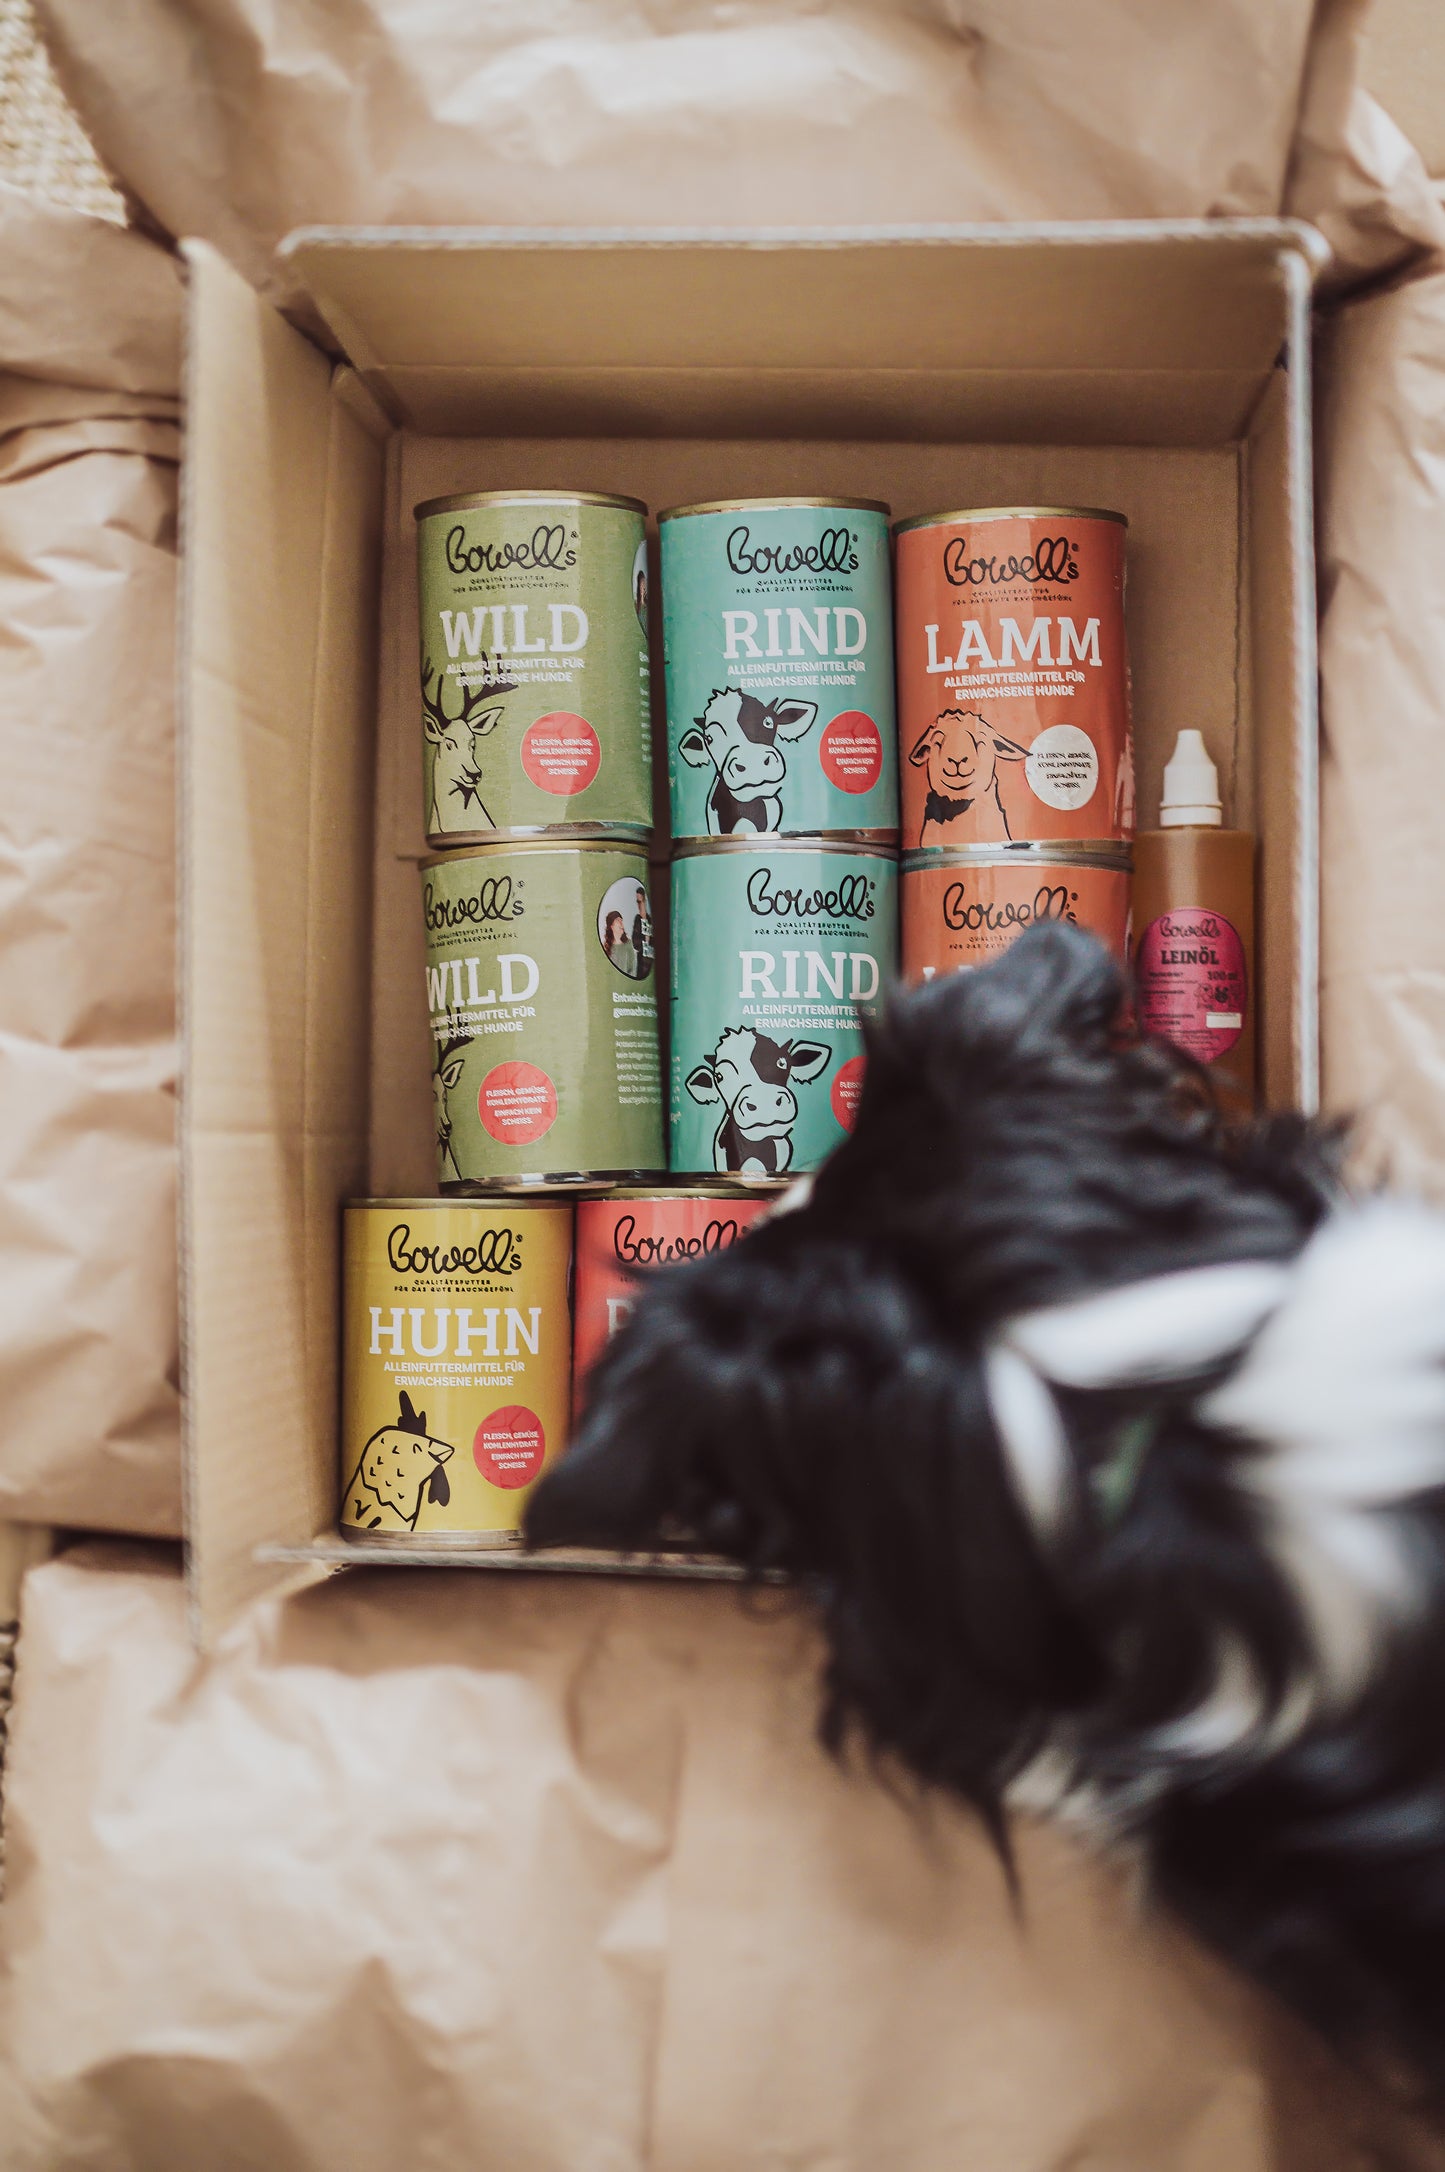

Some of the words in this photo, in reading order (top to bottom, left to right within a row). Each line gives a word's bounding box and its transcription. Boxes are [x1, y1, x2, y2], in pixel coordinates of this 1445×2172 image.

[446, 524, 577, 573] Bowell's
[727, 526, 859, 575] Bowell's
[944, 537, 1079, 586] Bowell's
[439, 604, 590, 658] WILD
[722, 607, 867, 659] RIND
[924, 617, 1102, 674] LAMM
[563, 657, 585, 669] FÜR
[727, 661, 847, 675] ALLEINFUTTERMITTEL
[848, 659, 866, 672] FÜR
[531, 672, 573, 683] HUNDE
[740, 675, 820, 688] ERWACHSENE
[821, 674, 856, 686] HUNDE
[944, 671, 1066, 688] ALLEINFUTTERMITTEL
[1066, 669, 1086, 683] FÜR
[955, 685, 1034, 700] ERWACHSENE
[1036, 685, 1075, 696] HUNDE
[747, 868, 875, 921] Bowell's
[1161, 946, 1219, 965] LEINÖL
[425, 954, 540, 1012] WILD
[738, 951, 879, 1000] RIND
[512, 1005, 536, 1019] FÜR
[484, 1021, 523, 1034] HUNDE
[755, 1017, 834, 1029] ERWACHSENE
[388, 1224, 522, 1275] Bowell's
[414, 1278, 491, 1286] QUALITÄTSFUTTER
[369, 1306, 541, 1356] HUHN
[383, 1361, 503, 1373] ALLEINFUTTERMITTEL
[504, 1360, 525, 1372] FÜR
[395, 1375, 471, 1386] ERWACHSENE
[474, 1375, 514, 1386] HUNDE
